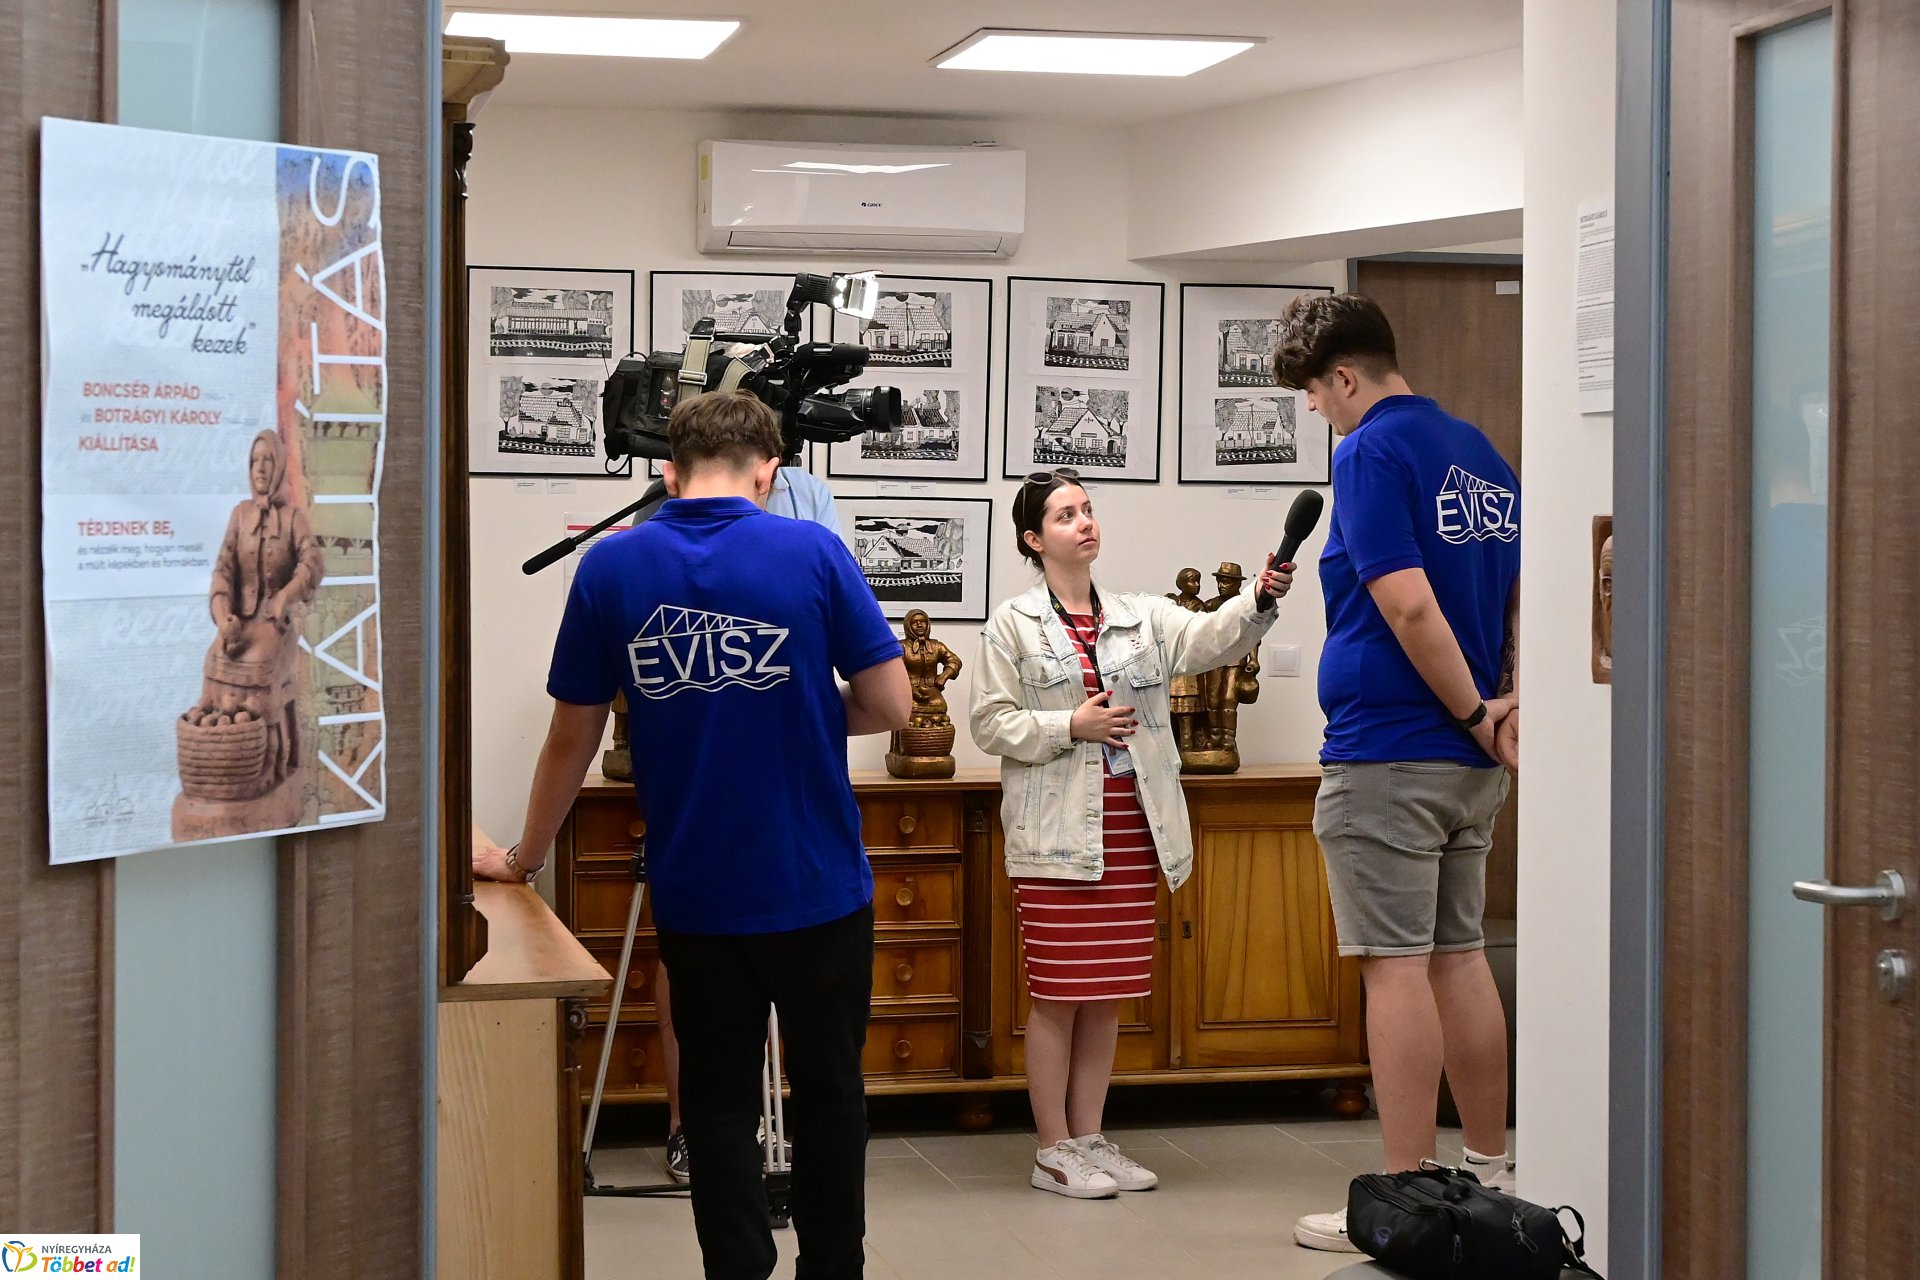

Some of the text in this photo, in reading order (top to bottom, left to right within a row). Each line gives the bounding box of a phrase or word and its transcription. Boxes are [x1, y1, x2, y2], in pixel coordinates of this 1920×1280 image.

[132, 293, 238, 339] megáldott
[82, 379, 150, 399] BONCSÉR
[153, 381, 201, 400] ÁRPÁD
[94, 404, 166, 424] BOTRÁGYI
[169, 407, 223, 425] KÁROLY
[78, 432, 160, 452] KIÁLLÍTÁSA
[294, 154, 387, 824] KIÁLLÍTÁS
[1436, 491, 1518, 532] EVISZ
[77, 518, 176, 539] TÉRJENEK BE,
[627, 627, 791, 684] EVISZ
